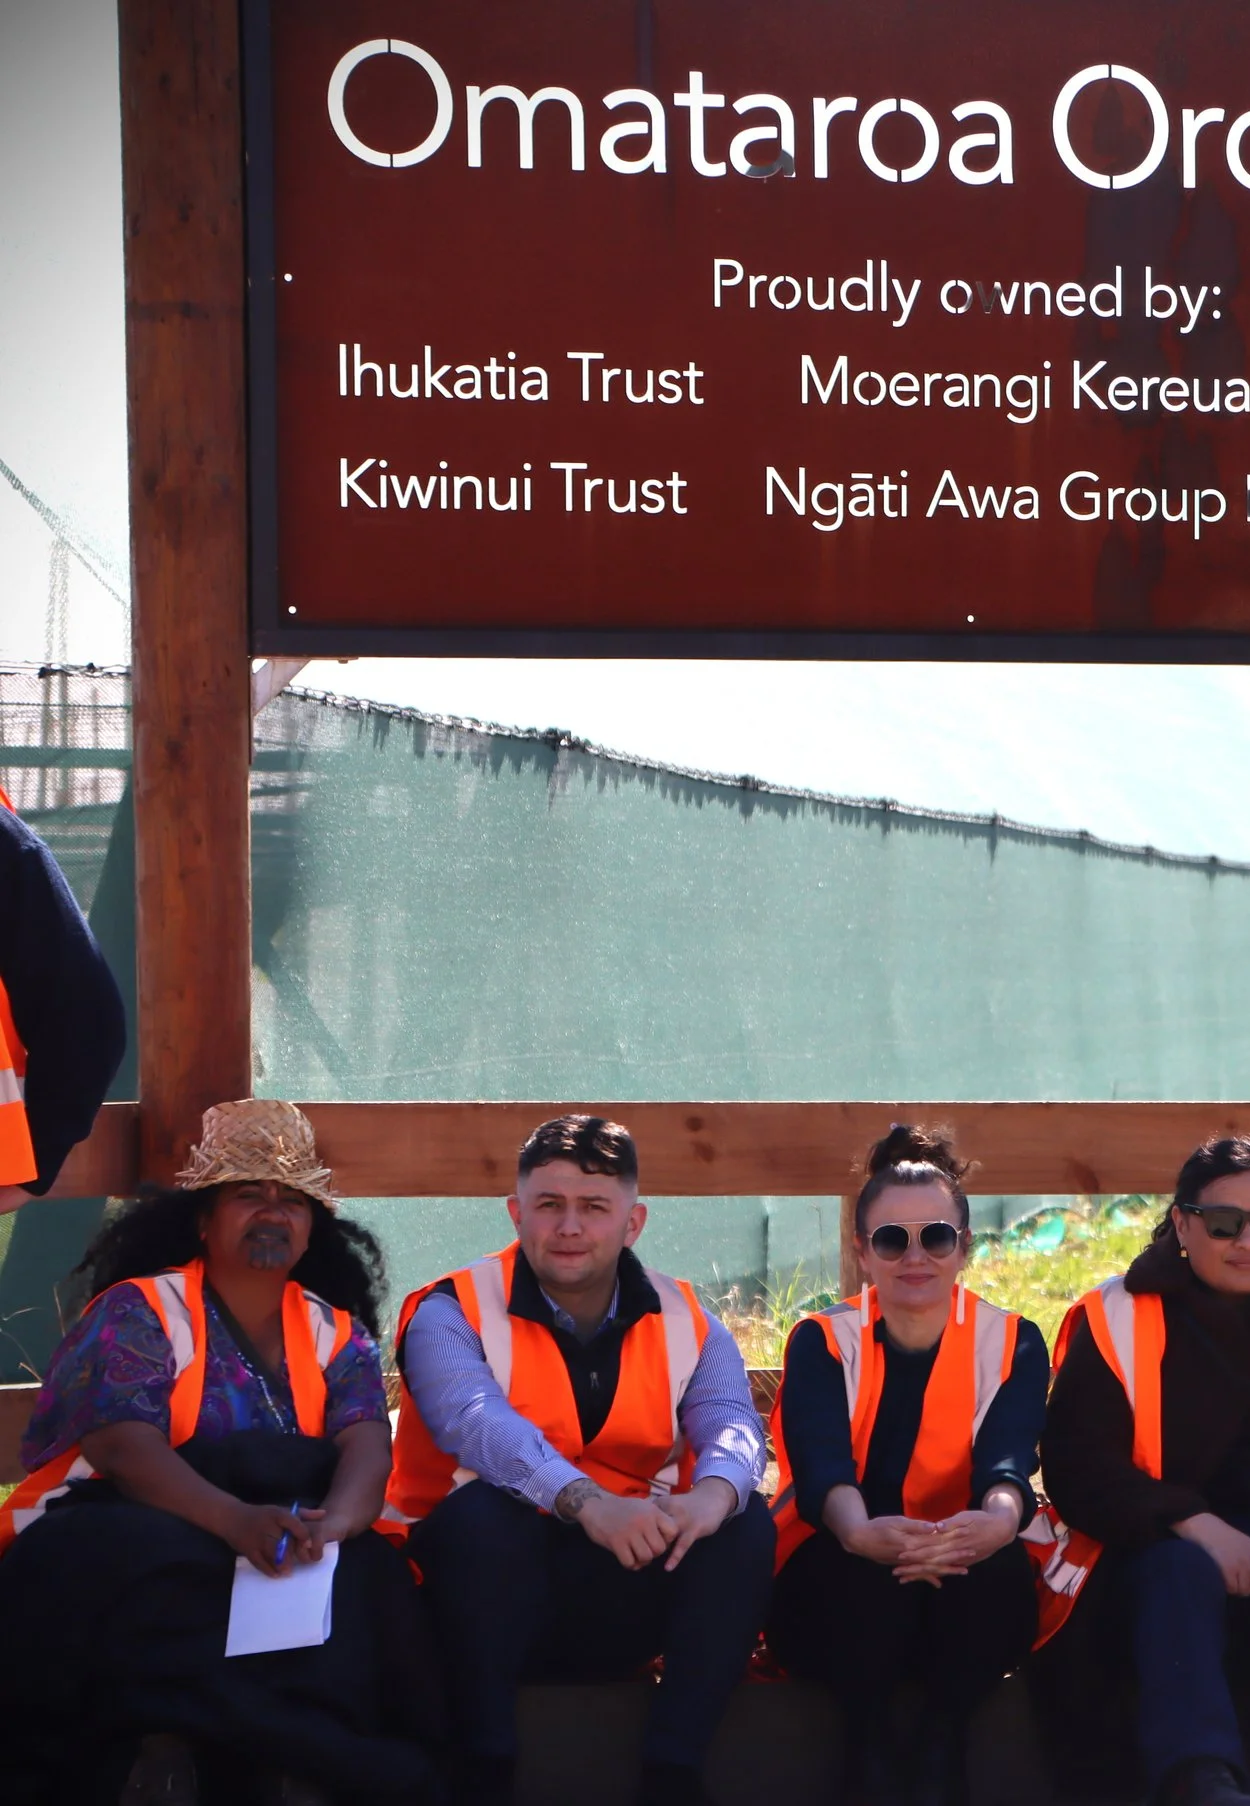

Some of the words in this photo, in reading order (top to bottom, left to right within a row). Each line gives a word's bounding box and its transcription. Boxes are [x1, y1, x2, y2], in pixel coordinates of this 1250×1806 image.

[326, 38, 1014, 186] Omataroa
[713, 258, 922, 328] Proudly
[940, 265, 1123, 319] owned
[1145, 265, 1222, 334] by:
[339, 343, 549, 402] Ihukatia
[566, 351, 705, 406] Trust
[801, 354, 1052, 424] Moerangi
[1073, 359, 1250, 414] Kereua
[340, 457, 532, 512] Kiwinui
[549, 461, 688, 515] Trust
[766, 466, 909, 532] Ngāti
[926, 469, 1041, 521] Awa
[1059, 470, 1228, 540] Group
